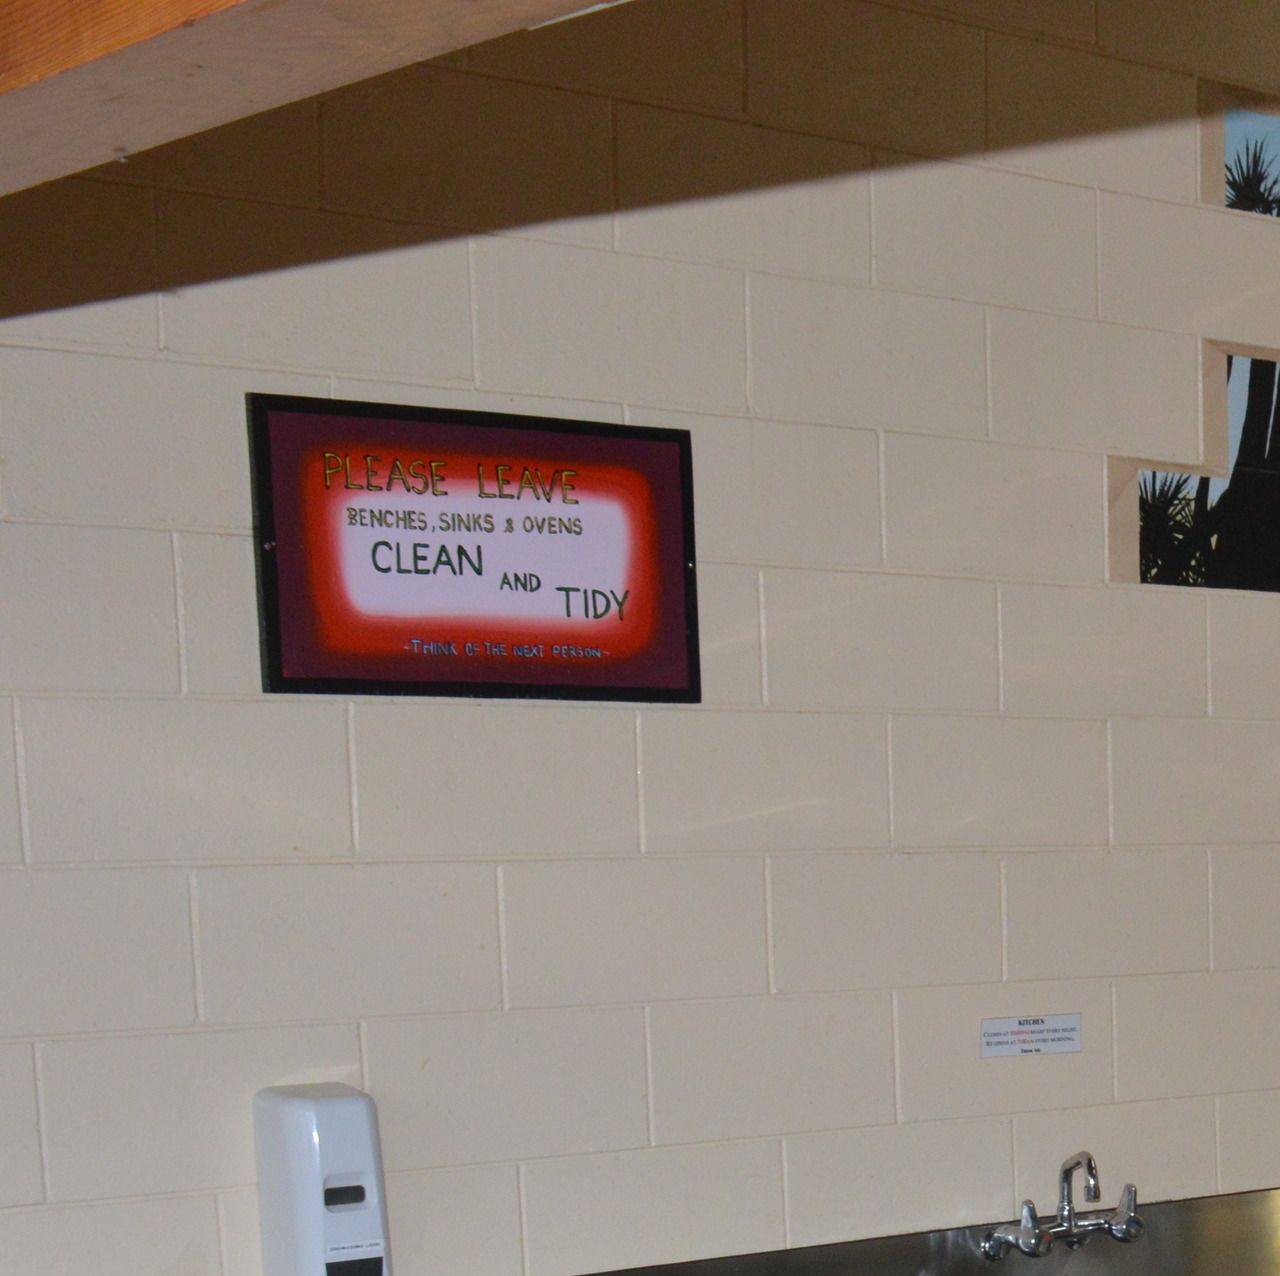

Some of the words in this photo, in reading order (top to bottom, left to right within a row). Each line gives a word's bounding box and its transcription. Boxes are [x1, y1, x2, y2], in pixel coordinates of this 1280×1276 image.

[322, 452, 449, 496] PLEASE
[477, 462, 580, 505] LEAVE
[438, 512, 495, 534] SINKS
[522, 515, 583, 536] OVENS
[370, 540, 484, 577] CLEAN
[499, 572, 542, 594] AND
[555, 586, 631, 621] TIDY
[484, 641, 508, 656] THE
[513, 644, 545, 657] NEXT
